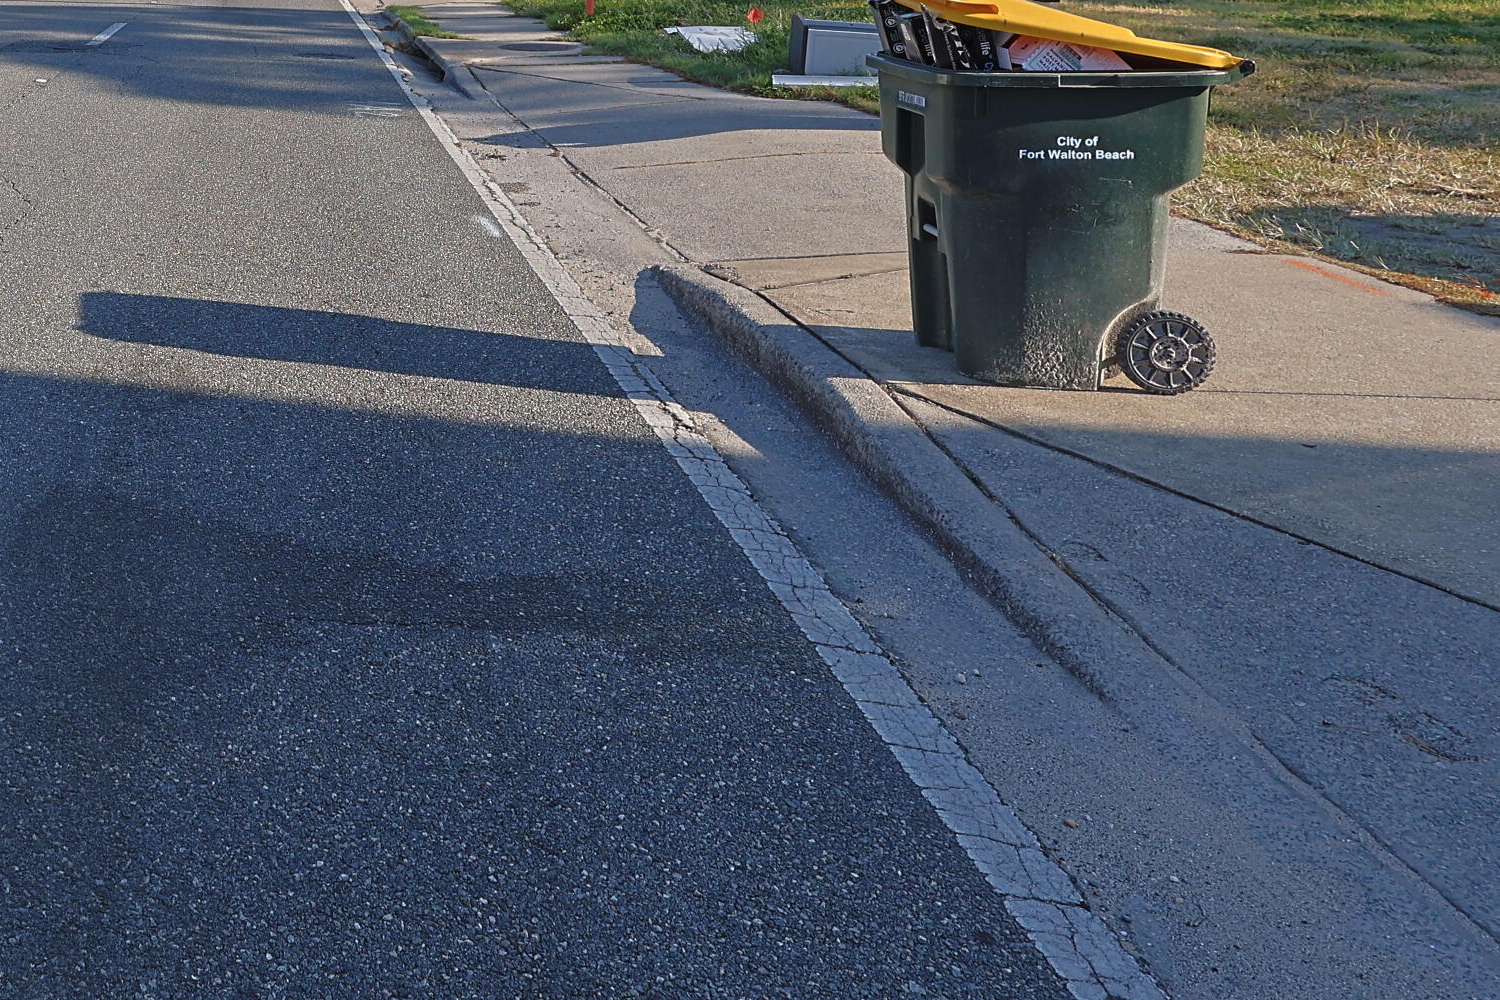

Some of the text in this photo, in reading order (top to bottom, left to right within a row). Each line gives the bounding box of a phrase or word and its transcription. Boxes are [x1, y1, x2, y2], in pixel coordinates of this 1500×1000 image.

[1056, 136, 1099, 149] City of
[1019, 149, 1135, 160] Fort Walton Beach
